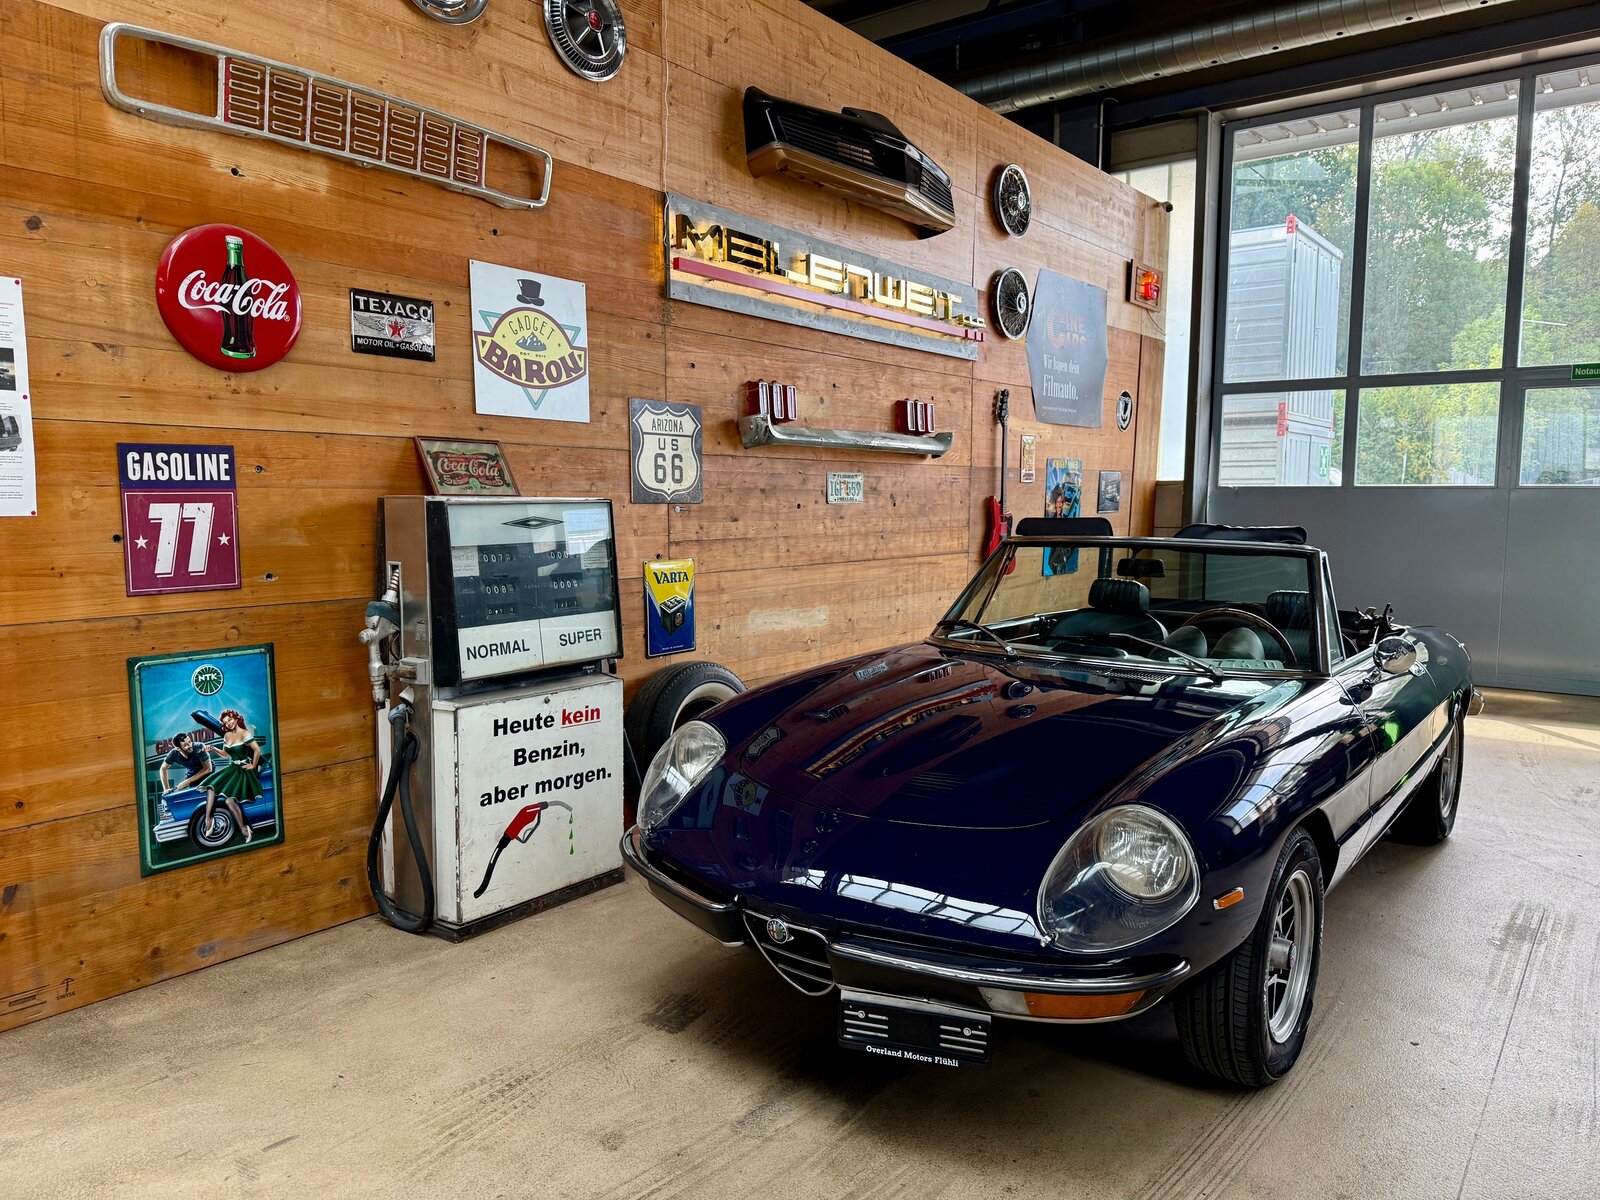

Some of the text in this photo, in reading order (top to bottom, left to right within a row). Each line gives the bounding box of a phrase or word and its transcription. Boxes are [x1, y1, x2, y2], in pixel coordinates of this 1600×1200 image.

[177, 269, 290, 321] Coca-Cola
[355, 295, 432, 321] TEXACO
[508, 315, 556, 340] GADGET
[357, 337, 383, 347] MOTOR
[384, 340, 396, 349] OIL
[482, 339, 583, 384] BARON
[1043, 374, 1079, 400] Filmauto.
[651, 418, 684, 433] ARIZONA
[126, 451, 231, 481] GASOLINE
[654, 452, 684, 484] 66
[148, 502, 216, 578] 77
[653, 570, 689, 585] VARTA
[466, 628, 602, 661] NORMAL SUPER
[198, 673, 218, 682] NTK
[493, 704, 602, 737] Heute kein
[513, 739, 586, 767] Benzin,
[479, 766, 612, 807] aber morgen.
[866, 1045, 959, 1067] Overland Motors Flühli
